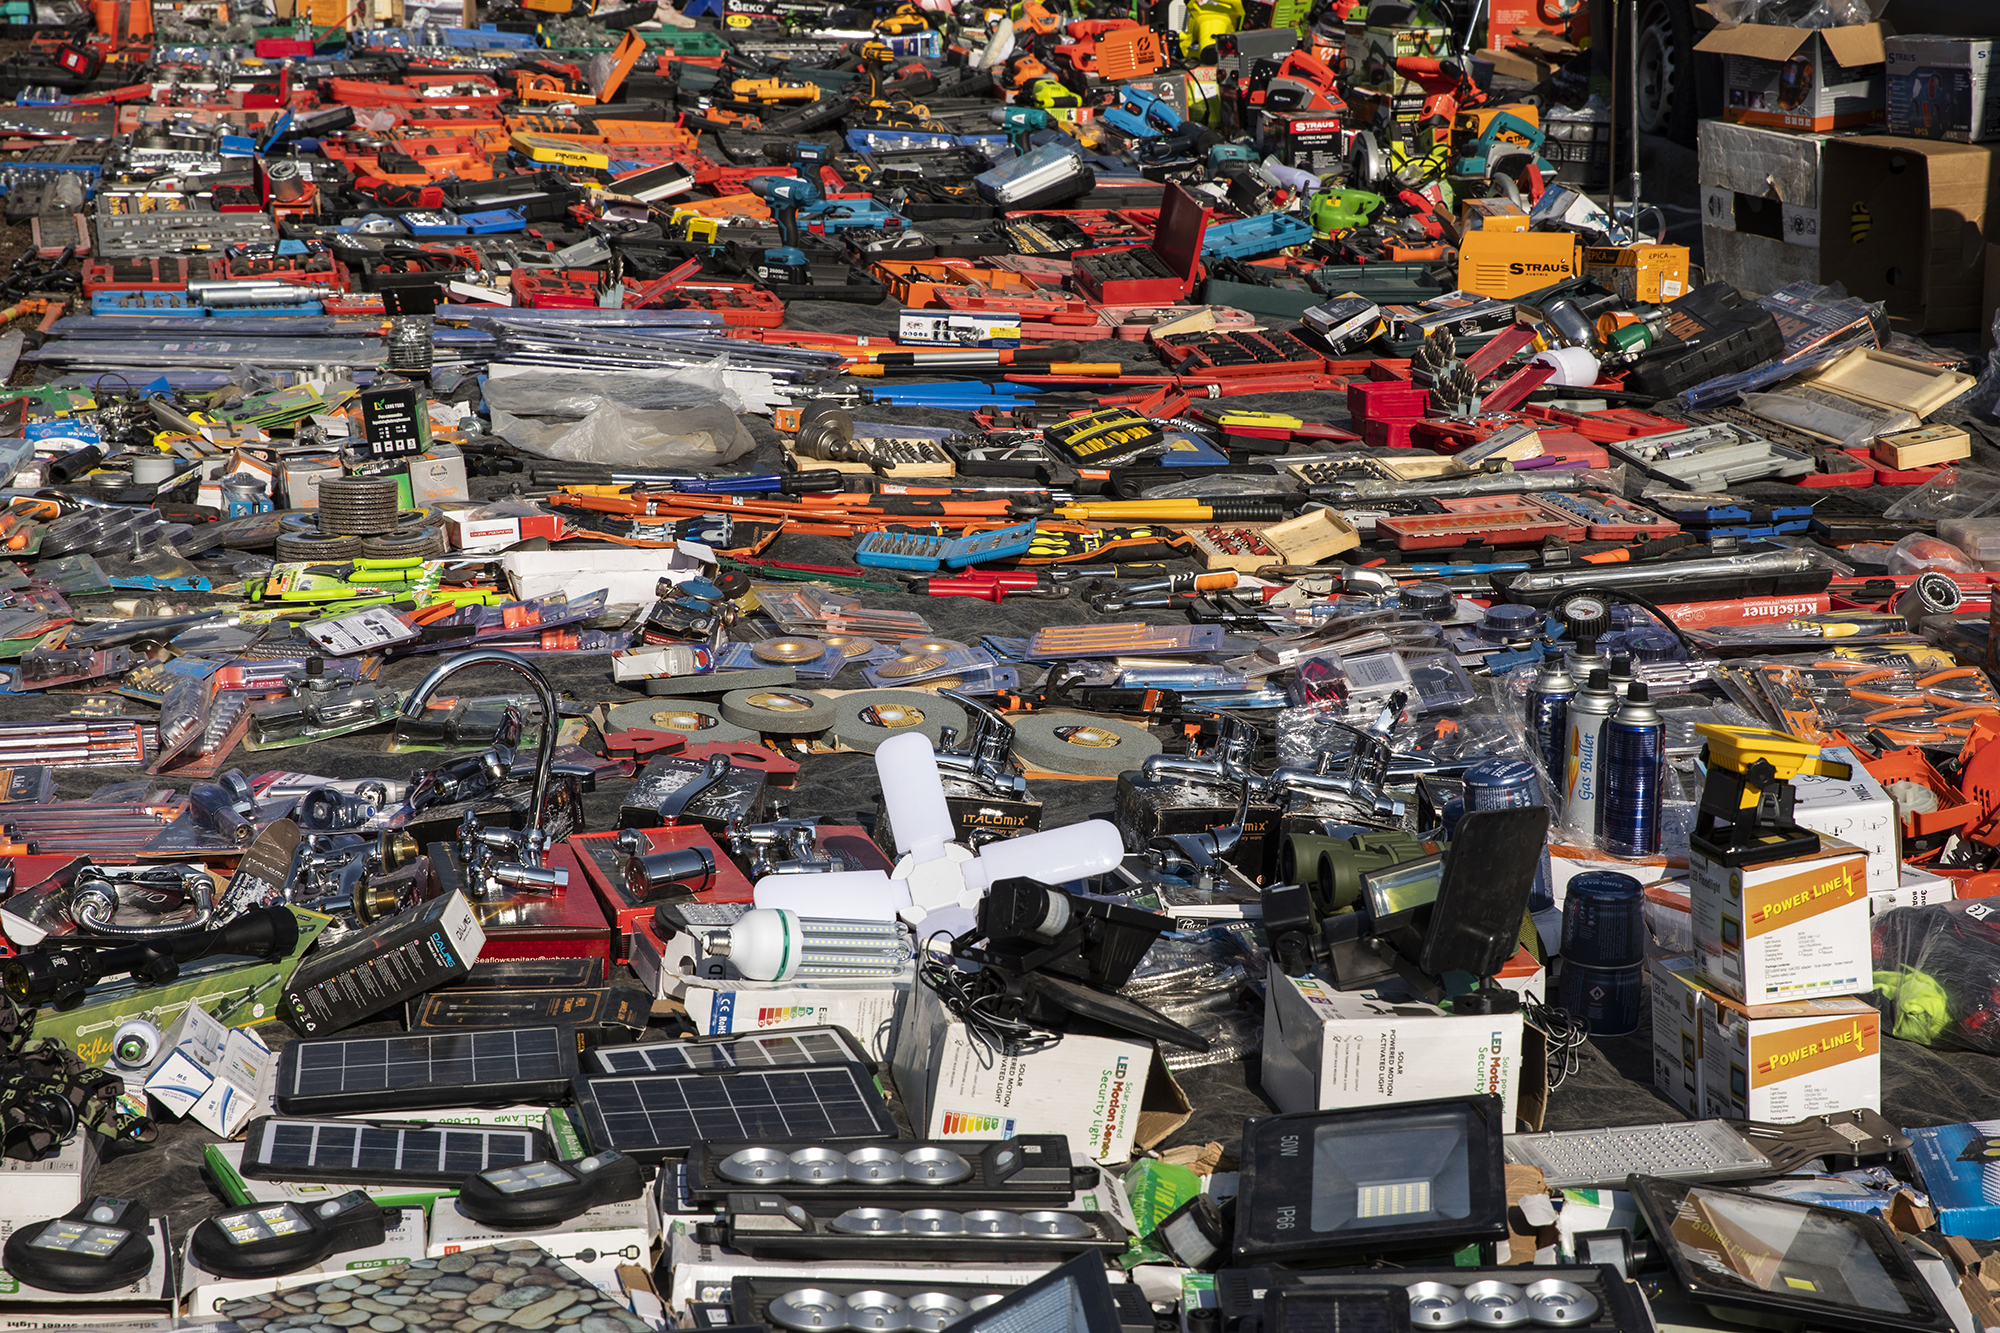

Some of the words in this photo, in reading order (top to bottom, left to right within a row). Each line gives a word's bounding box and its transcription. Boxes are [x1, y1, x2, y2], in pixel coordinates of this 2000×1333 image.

[728, 16, 749, 25] 2.5T
[1888, 51, 1916, 64] STRAUS
[1295, 121, 1335, 132] STRAUS
[1587, 250, 1608, 261] EPICA
[1648, 252, 1669, 260] EPICA
[1509, 262, 1570, 276] STRAUS
[1742, 602, 1818, 618] Krischner
[1578, 732, 1595, 773] Bullet
[1578, 776, 1595, 801] Gas
[1117, 887, 1143, 897] GHT
[1762, 890, 1811, 919] POWER
[1812, 876, 1843, 899] LINE
[1226, 921, 1257, 931] IGHT
[719, 998, 731, 1013] CE
[1379, 1032, 1387, 1070] ACTIVATED
[1388, 1029, 1397, 1066] POWERED
[1490, 1031, 1502, 1055] LED
[1769, 1043, 1818, 1071] POWER
[1821, 1031, 1852, 1051] LINE
[1009, 1045, 1020, 1082] OWERED
[1017, 1063, 1026, 1087] SOLAR
[1115, 1056, 1129, 1080] LED
[1397, 1051, 1405, 1075] SOLAR
[1473, 1047, 1489, 1095] Security
[1502, 1056, 1510, 1078] Solar
[1377, 1069, 1385, 1094] LIGHT
[1387, 1066, 1395, 1097] MOTION
[1488, 1056, 1501, 1096] Motio
[995, 1083, 1003, 1104] LIGHT
[1004, 1082, 1014, 1108] MOTION
[1093, 1070, 1112, 1117] Security
[1107, 1081, 1124, 1122] Motion
[1123, 1082, 1133, 1102] Solar
[1088, 1119, 1098, 1147] Light
[1116, 1103, 1128, 1139] powered
[1100, 1124, 1116, 1159] Senso
[1280, 1134, 1299, 1159] 50W
[1154, 1177, 1177, 1208] PIR
[1276, 1205, 1296, 1231] IP66
[1697, 1247, 1730, 1276] IP66
